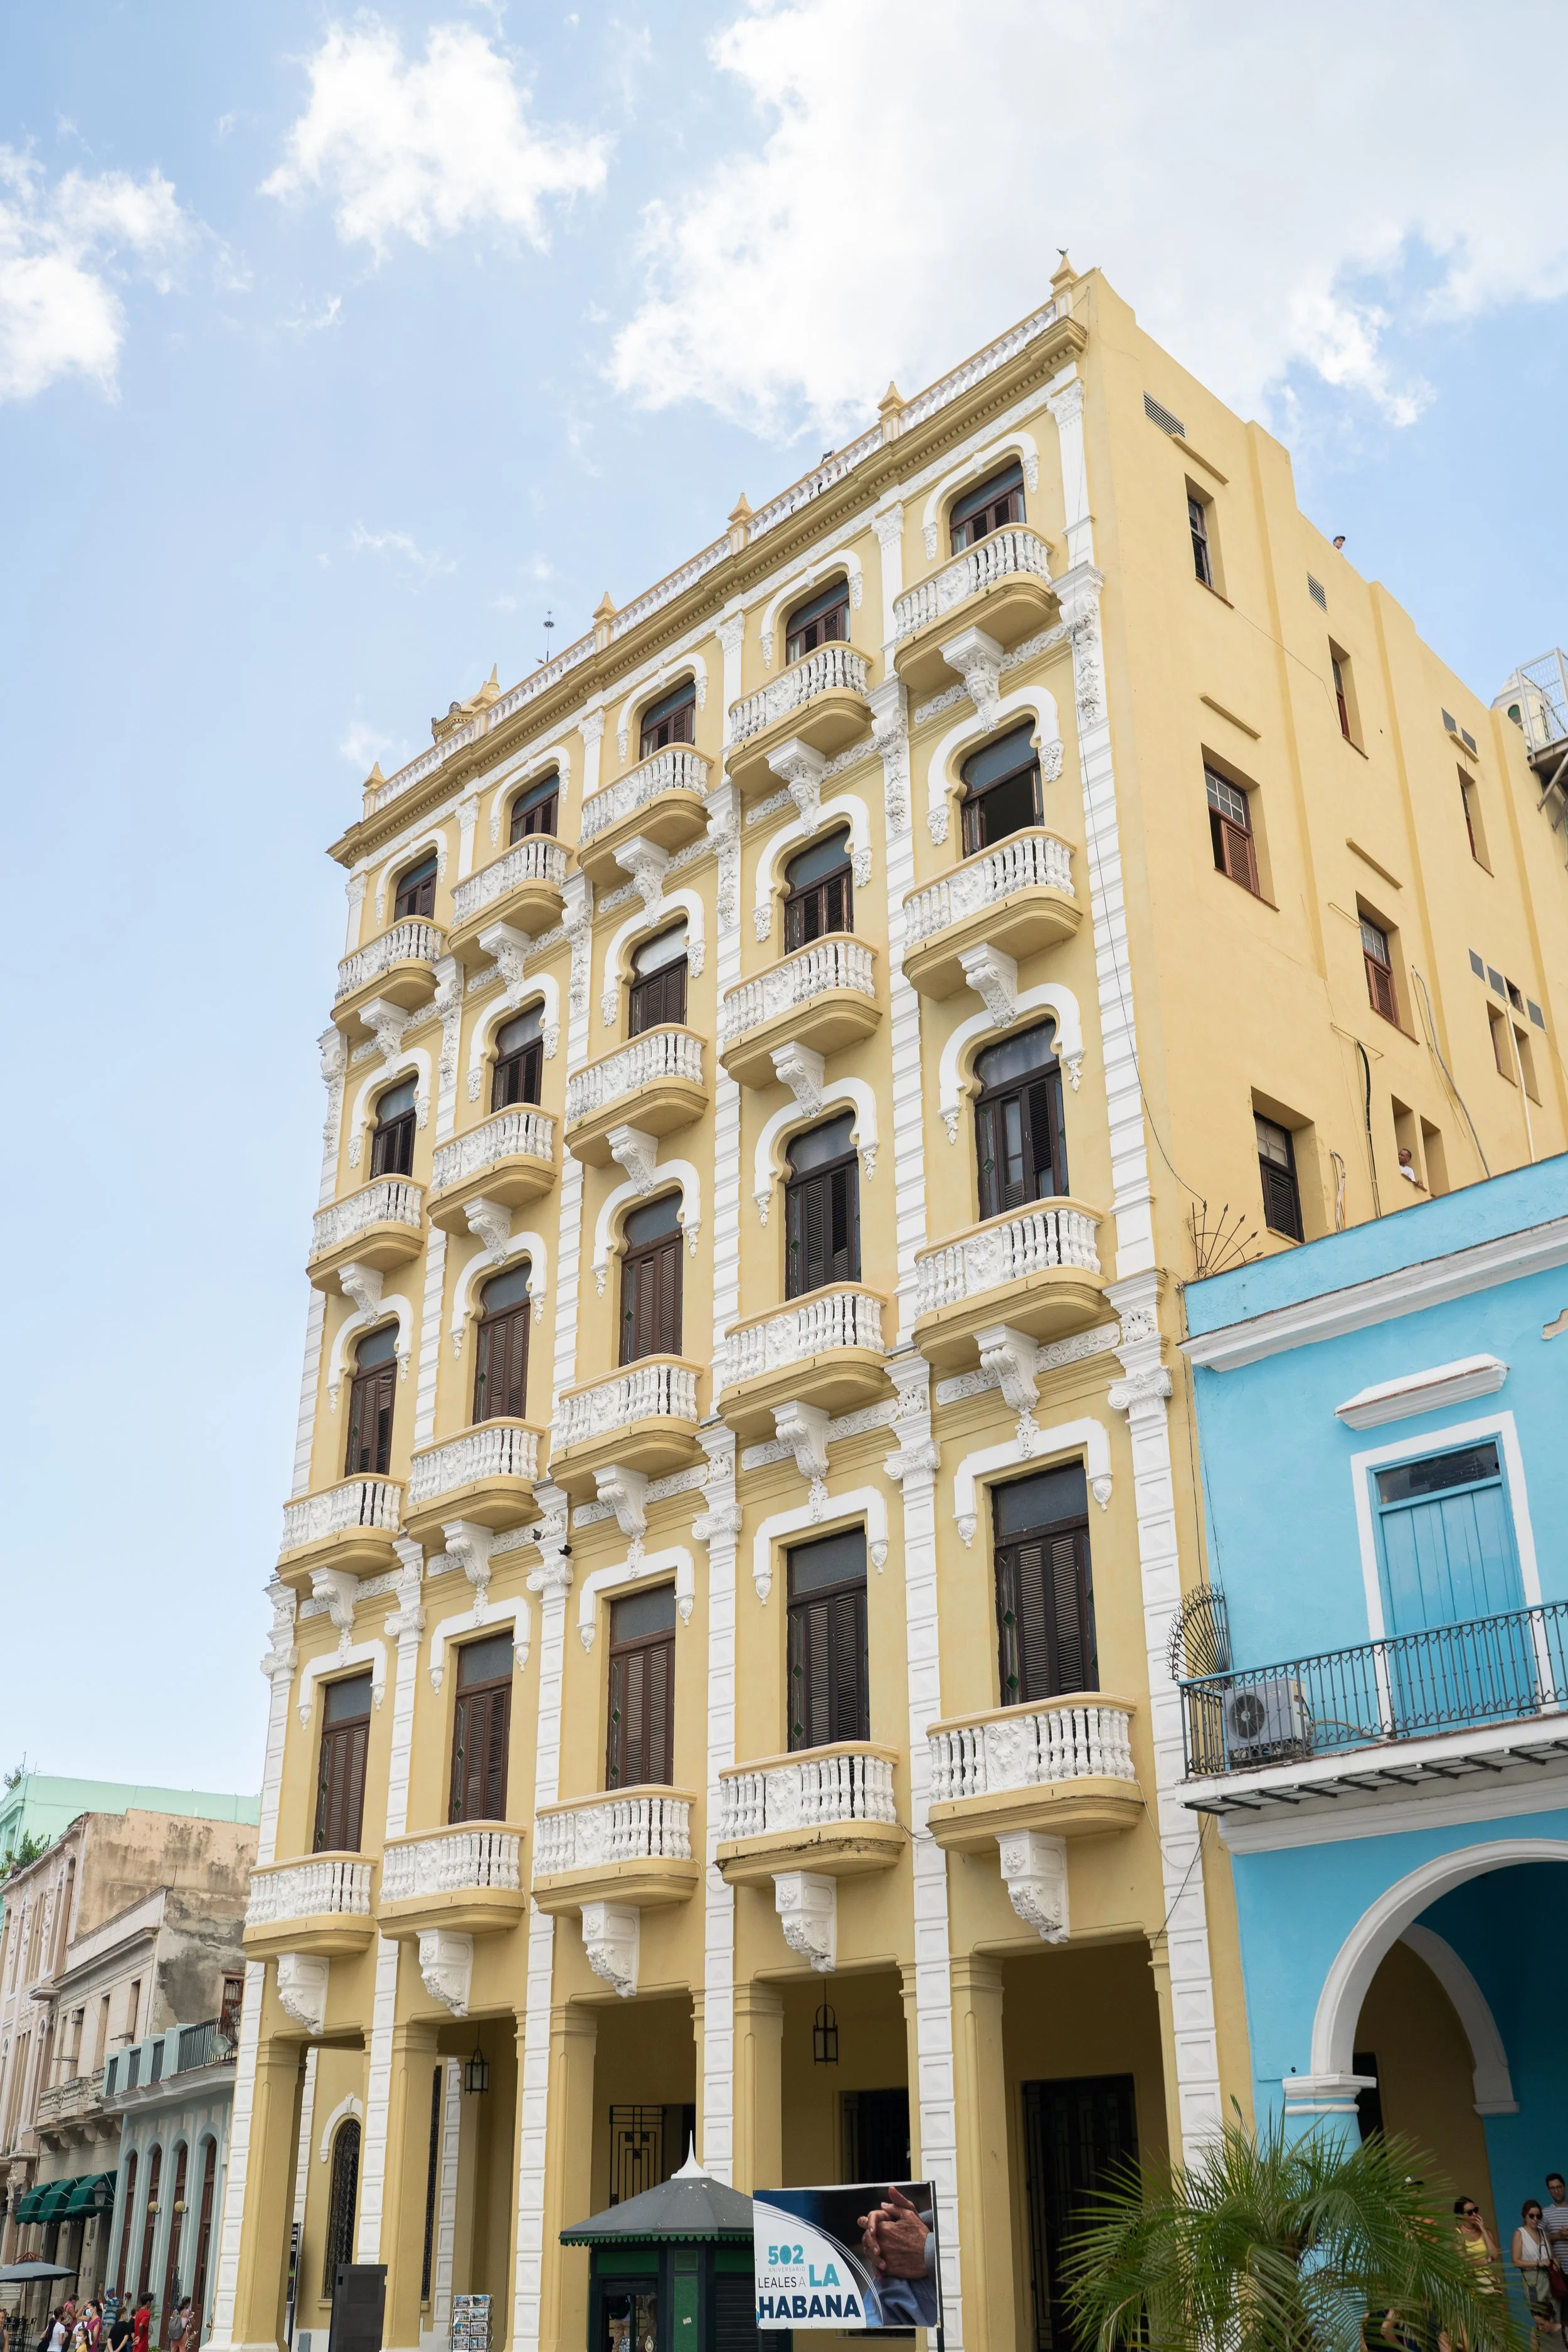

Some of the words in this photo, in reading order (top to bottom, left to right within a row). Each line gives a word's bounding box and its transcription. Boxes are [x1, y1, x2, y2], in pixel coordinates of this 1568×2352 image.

[768, 2244, 804, 2265] 502
[758, 2276, 797, 2288] LEALES
[798, 2275, 807, 2288] A
[808, 2263, 840, 2287] LA
[759, 2294, 861, 2319] HABANA
